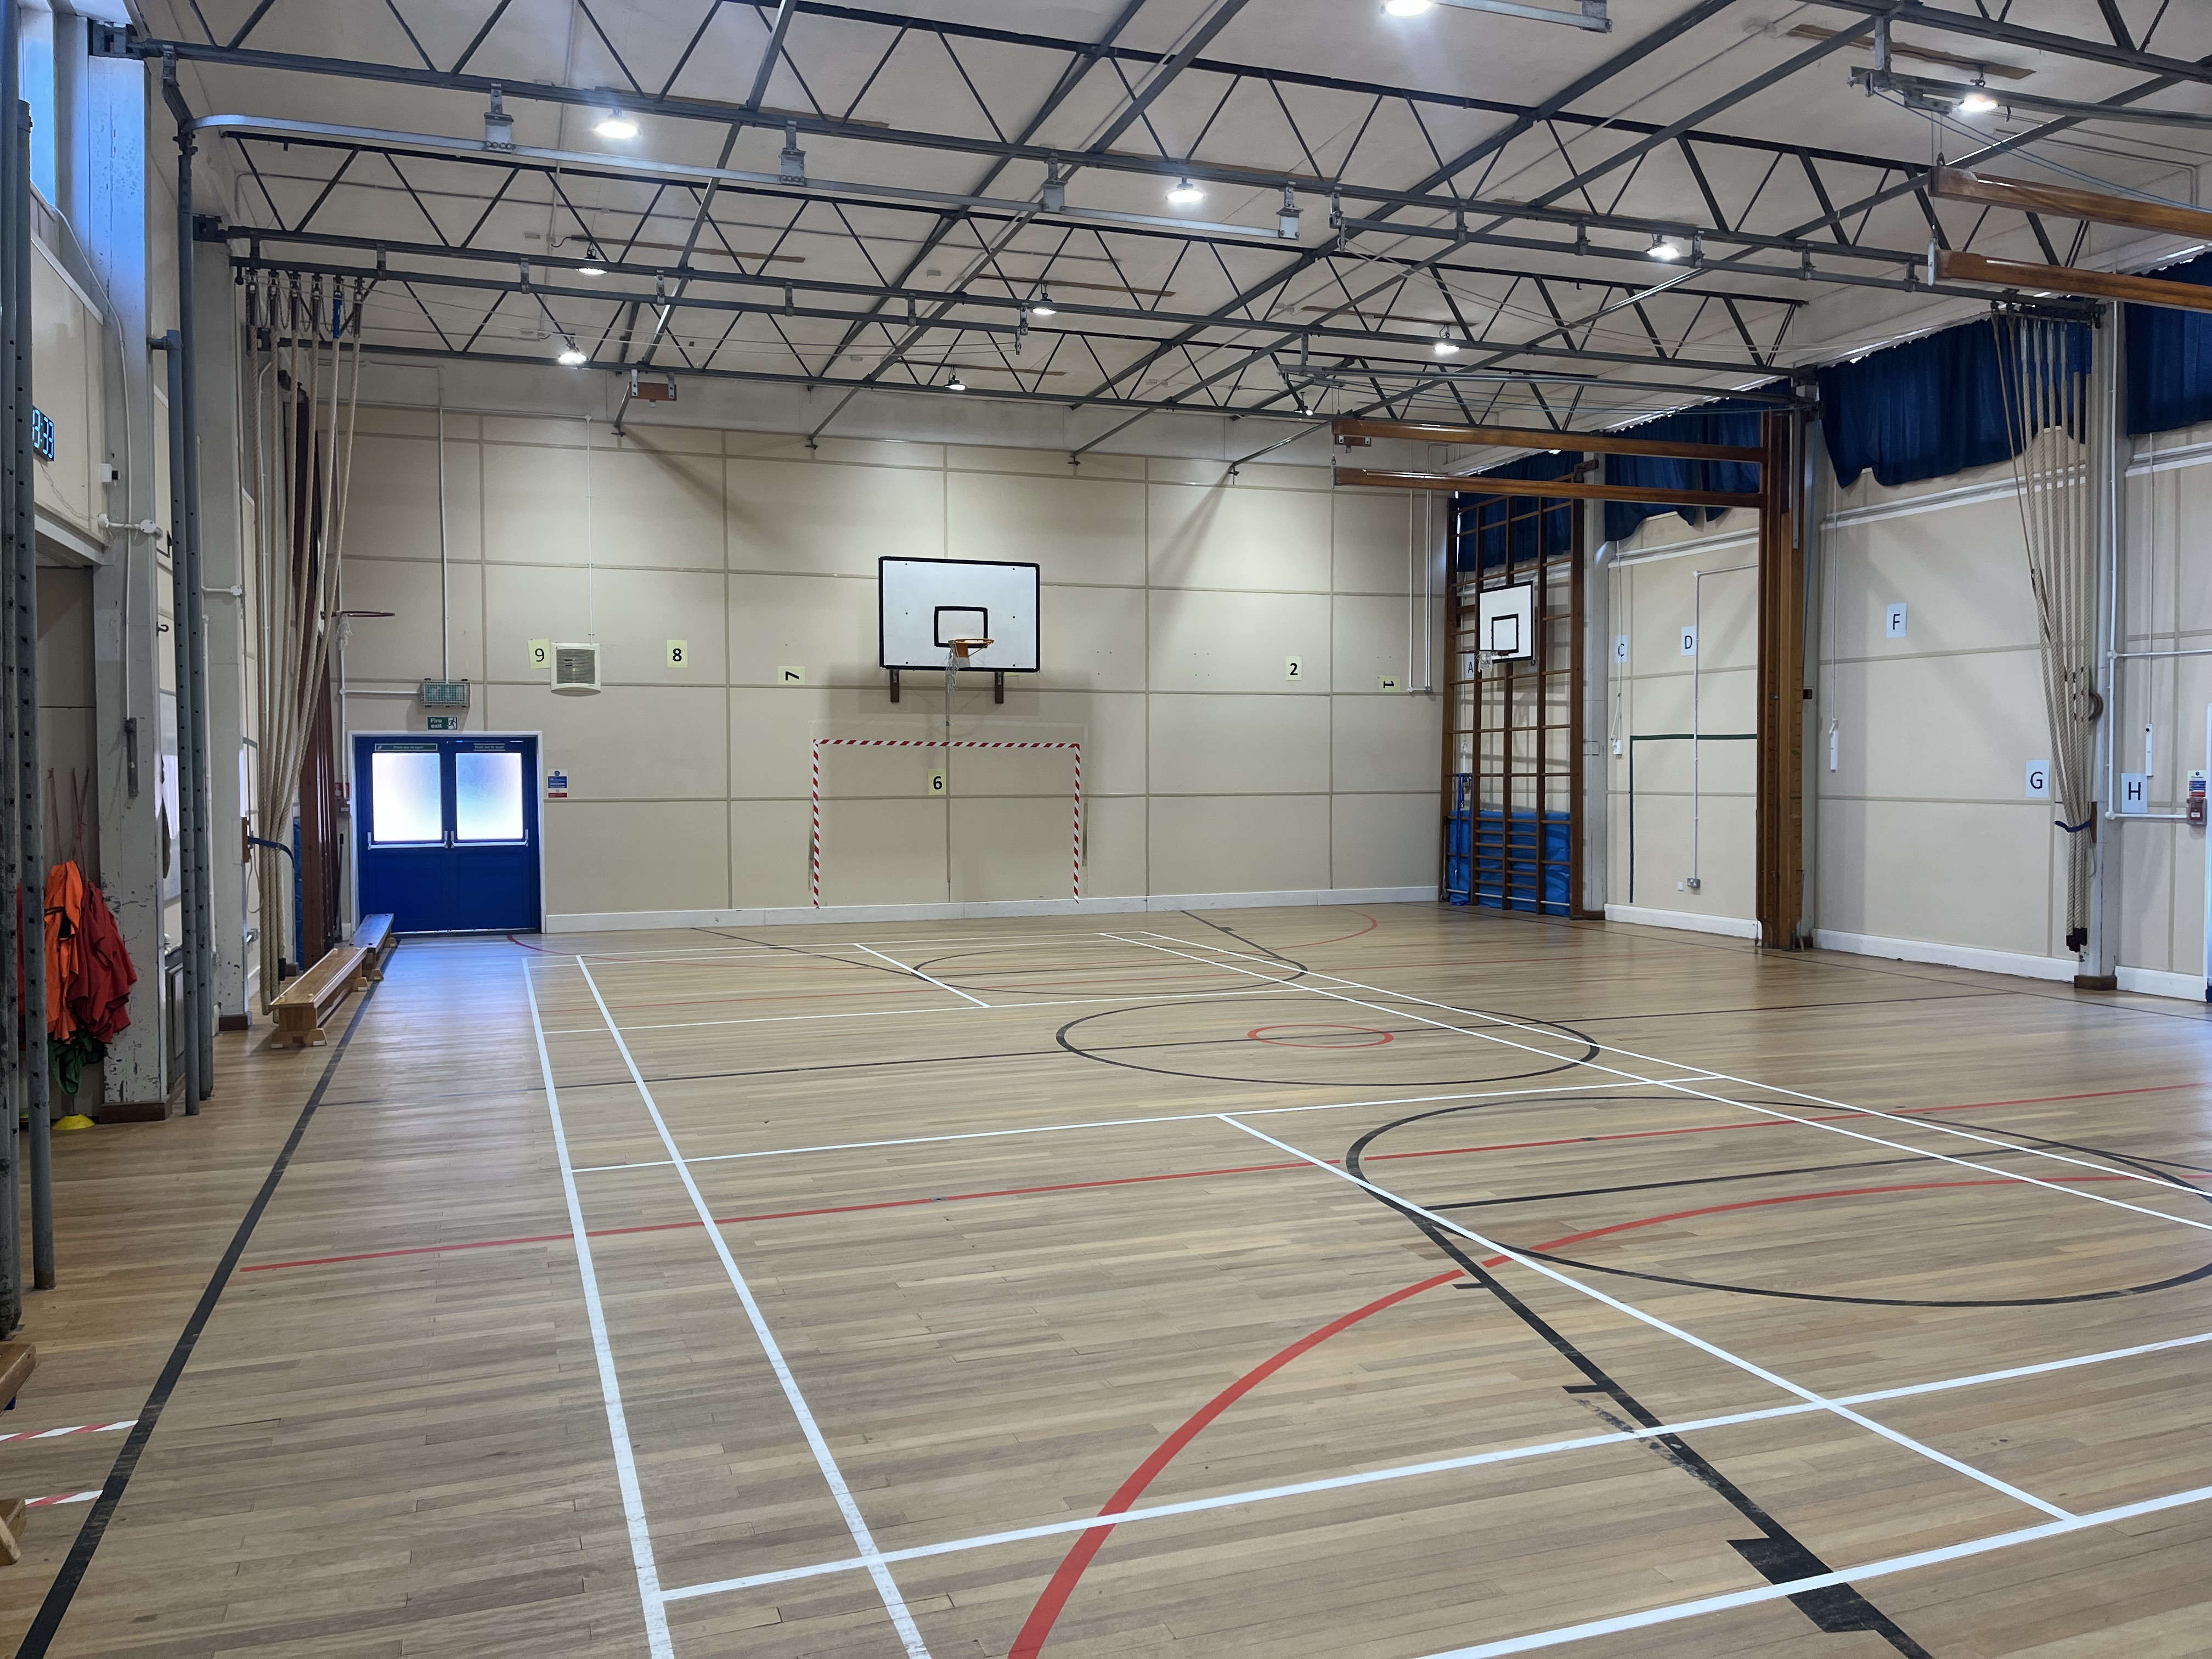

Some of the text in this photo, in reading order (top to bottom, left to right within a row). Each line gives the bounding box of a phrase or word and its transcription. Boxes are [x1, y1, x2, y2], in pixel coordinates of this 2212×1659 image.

[1893, 613, 1900, 630] F
[1685, 635, 1692, 650] D
[535, 648, 545, 662] 9
[673, 648, 682, 662] 8
[1617, 643, 1624, 657] C
[1290, 663, 1298, 676] 2
[1468, 661, 1474, 674] A
[785, 671, 799, 681] 7
[1383, 680, 1395, 689] 1
[933, 776, 943, 790] 6
[2030, 771, 2043, 789] G
[2128, 781, 2141, 801] H
